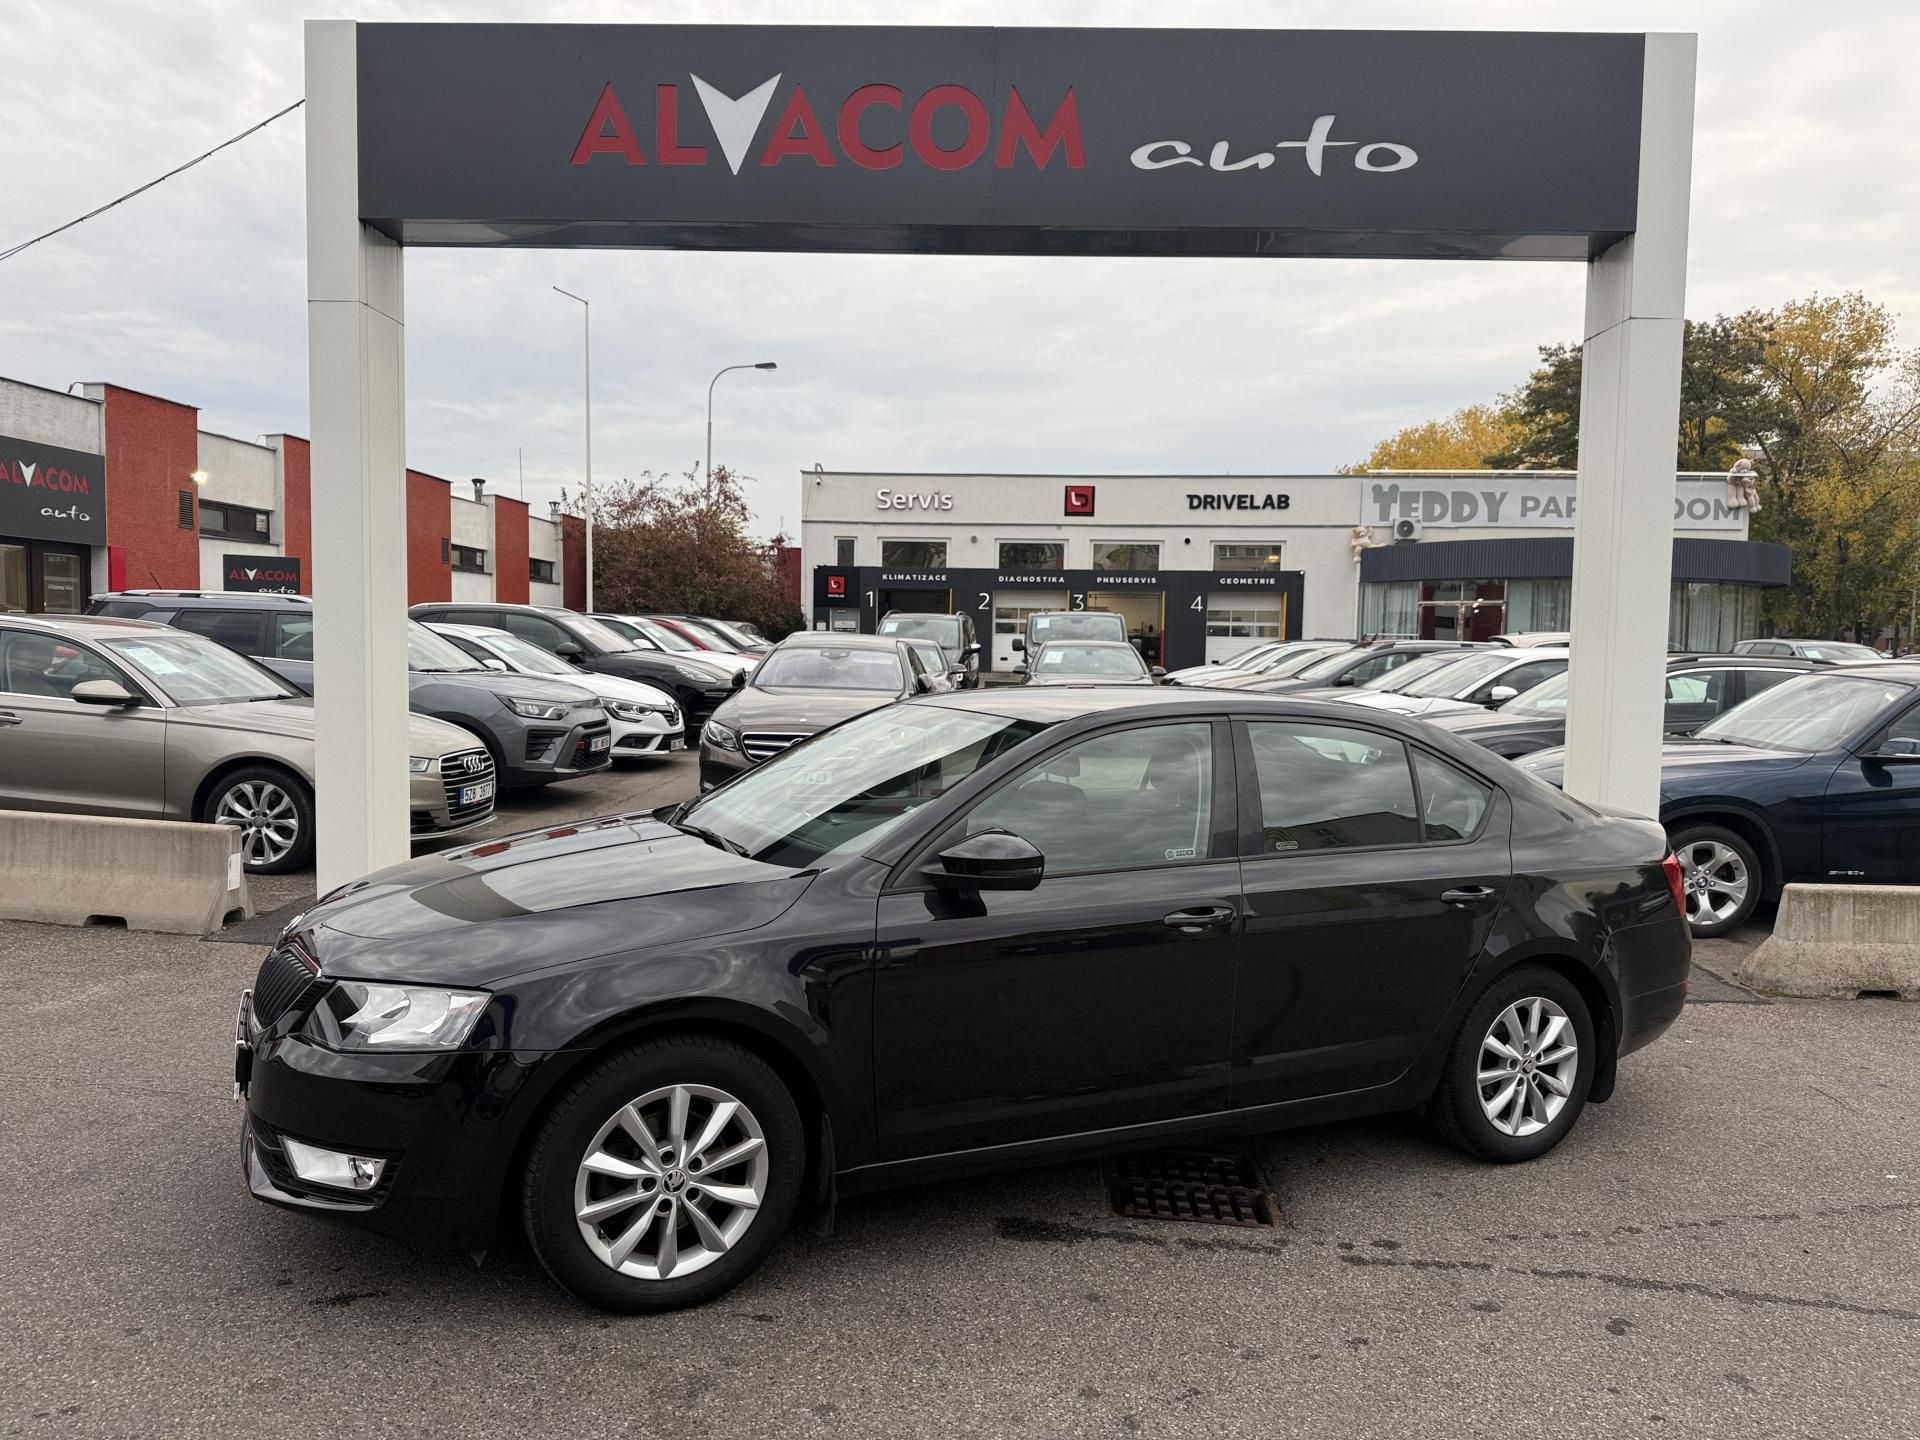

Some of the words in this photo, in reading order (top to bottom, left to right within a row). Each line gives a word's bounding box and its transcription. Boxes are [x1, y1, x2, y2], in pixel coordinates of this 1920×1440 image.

[569, 72, 1087, 175] ALVACOM
[1130, 114, 1419, 177] auto
[876, 488, 953, 510] Servis
[1186, 494, 1290, 510] DRIVELAB
[1372, 484, 1508, 523] TEDDY
[40, 505, 91, 521] auto
[229, 567, 297, 582] ALVACOM
[866, 591, 874, 607] 1
[978, 593, 990, 610] 2
[1072, 594, 1085, 611] 3
[1190, 595, 1203, 612] 4
